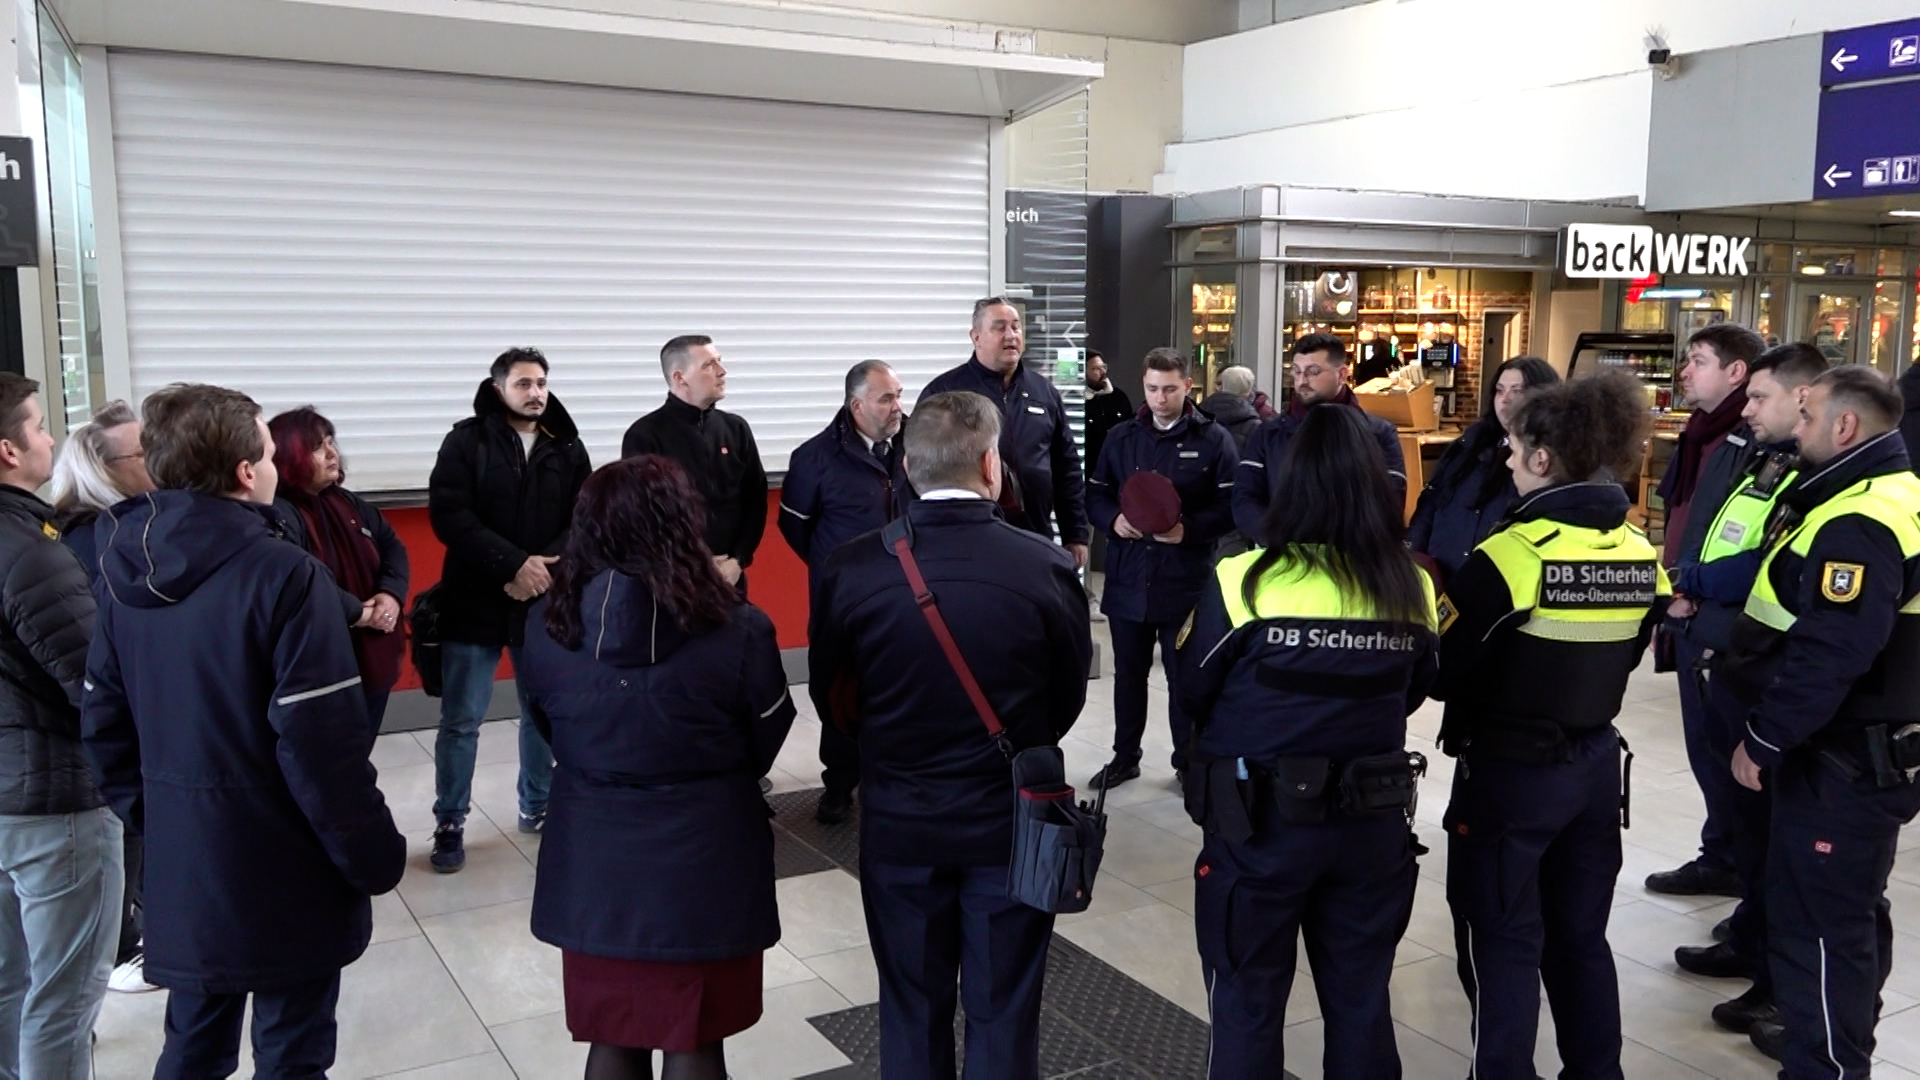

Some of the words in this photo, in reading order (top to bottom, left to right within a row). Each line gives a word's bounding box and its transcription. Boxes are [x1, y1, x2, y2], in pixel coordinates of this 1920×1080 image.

[1545, 565, 1575, 584] DB
[1266, 626, 1301, 647] DB
[1307, 628, 1416, 652] Sicherheit
